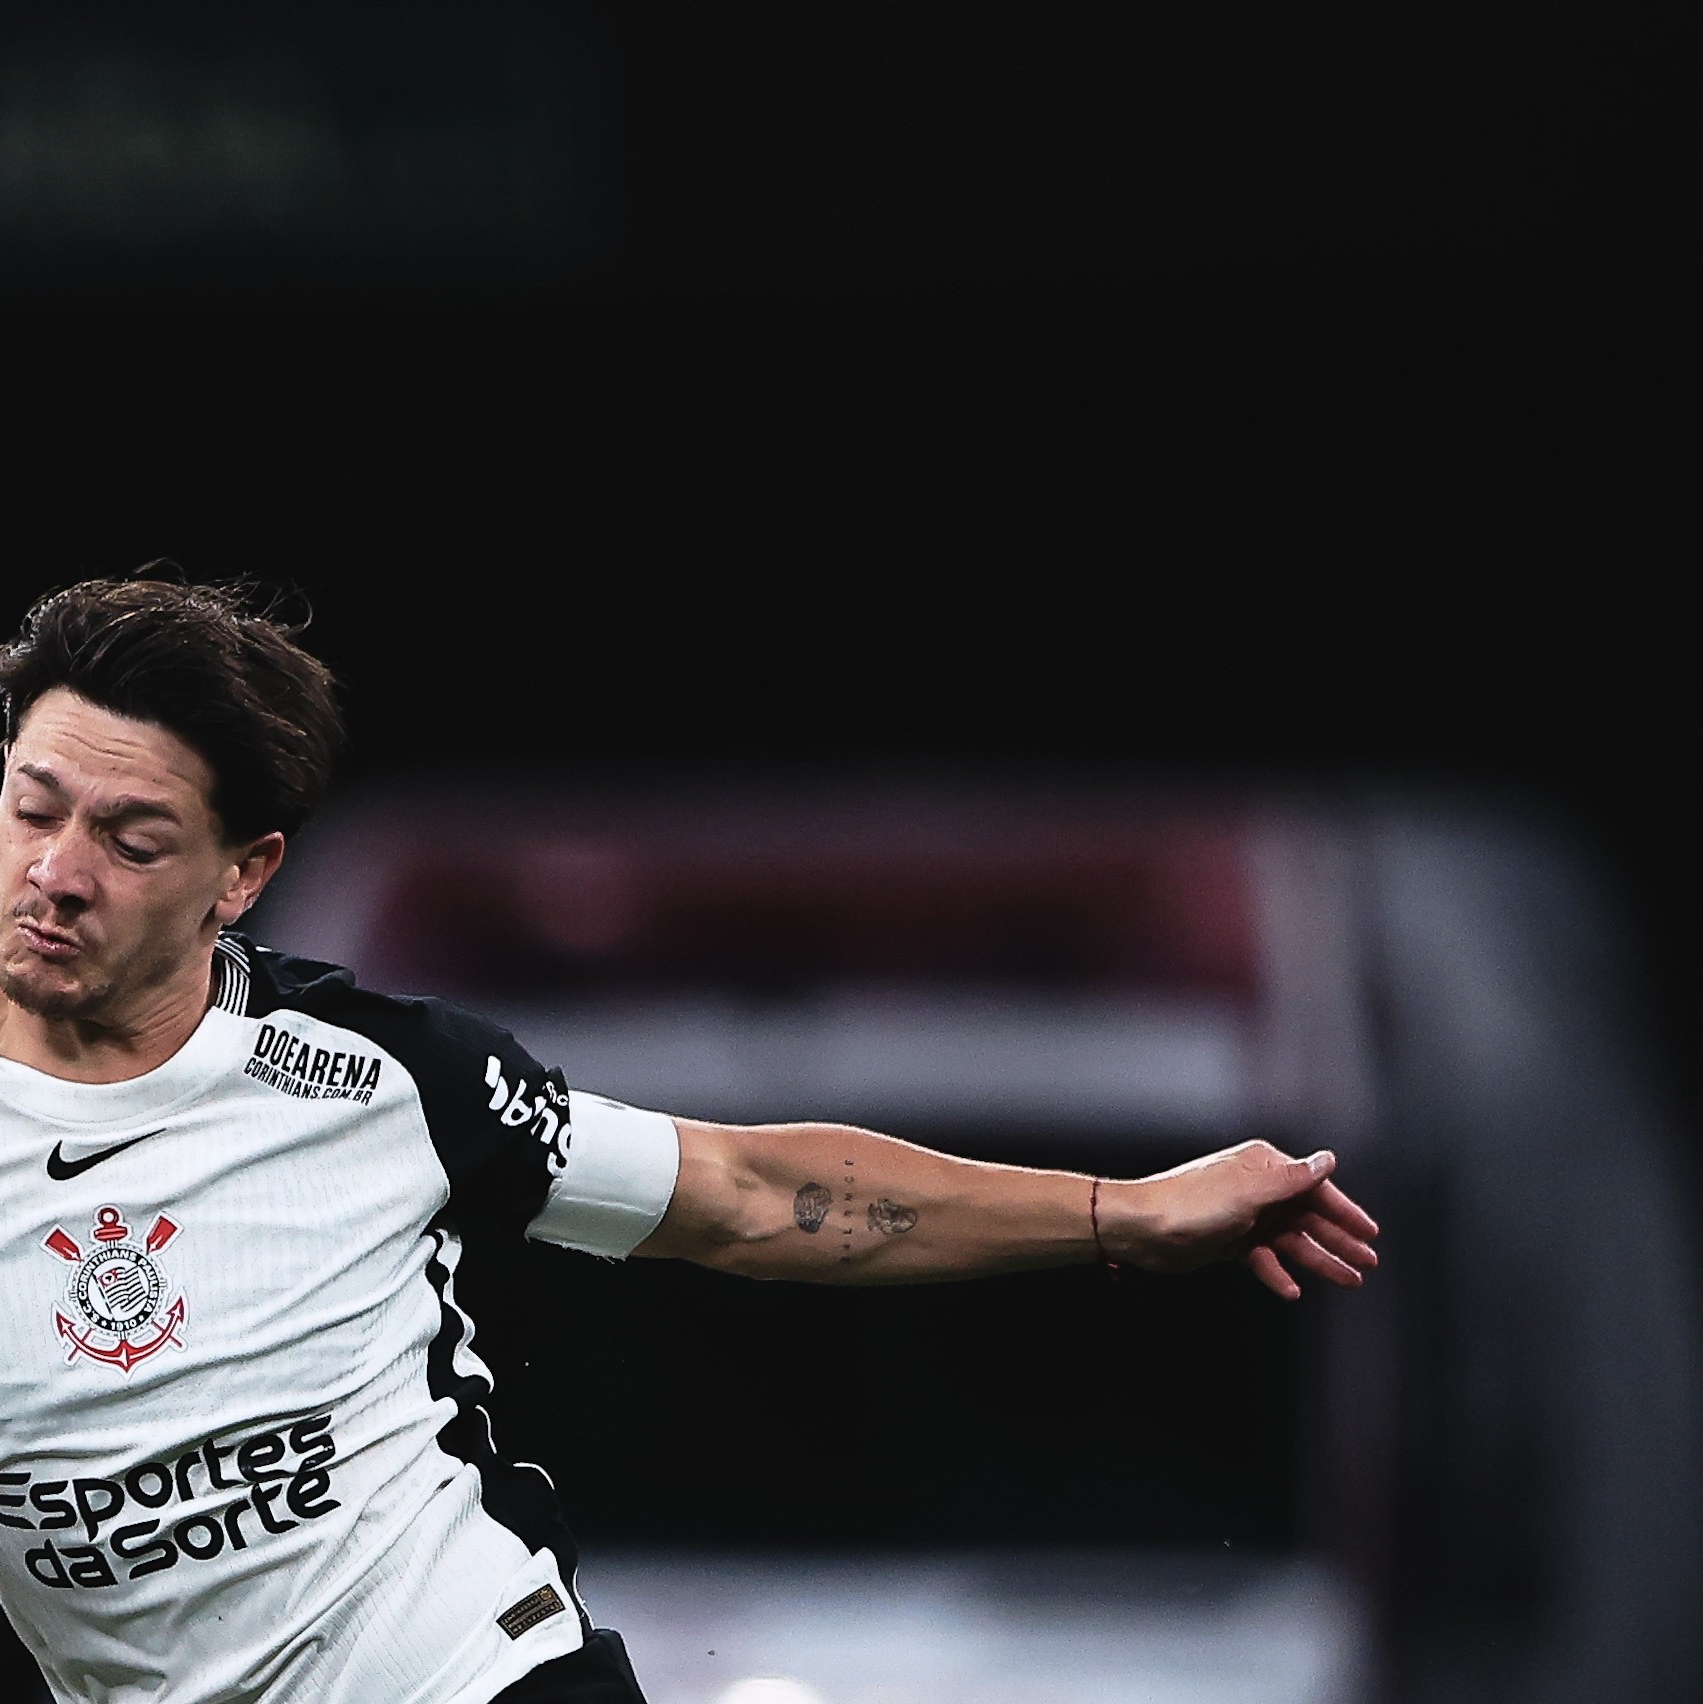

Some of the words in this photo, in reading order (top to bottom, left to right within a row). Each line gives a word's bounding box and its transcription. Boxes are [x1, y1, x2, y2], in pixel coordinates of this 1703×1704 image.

[243, 1057, 373, 1106] CORINTHIANS.COM.BR
[253, 1023, 382, 1090] DOEARENA
[78, 1249, 137, 1300] CORINTHIANS
[138, 1257, 160, 1313] PAULISTA
[110, 1320, 138, 1331] 1910
